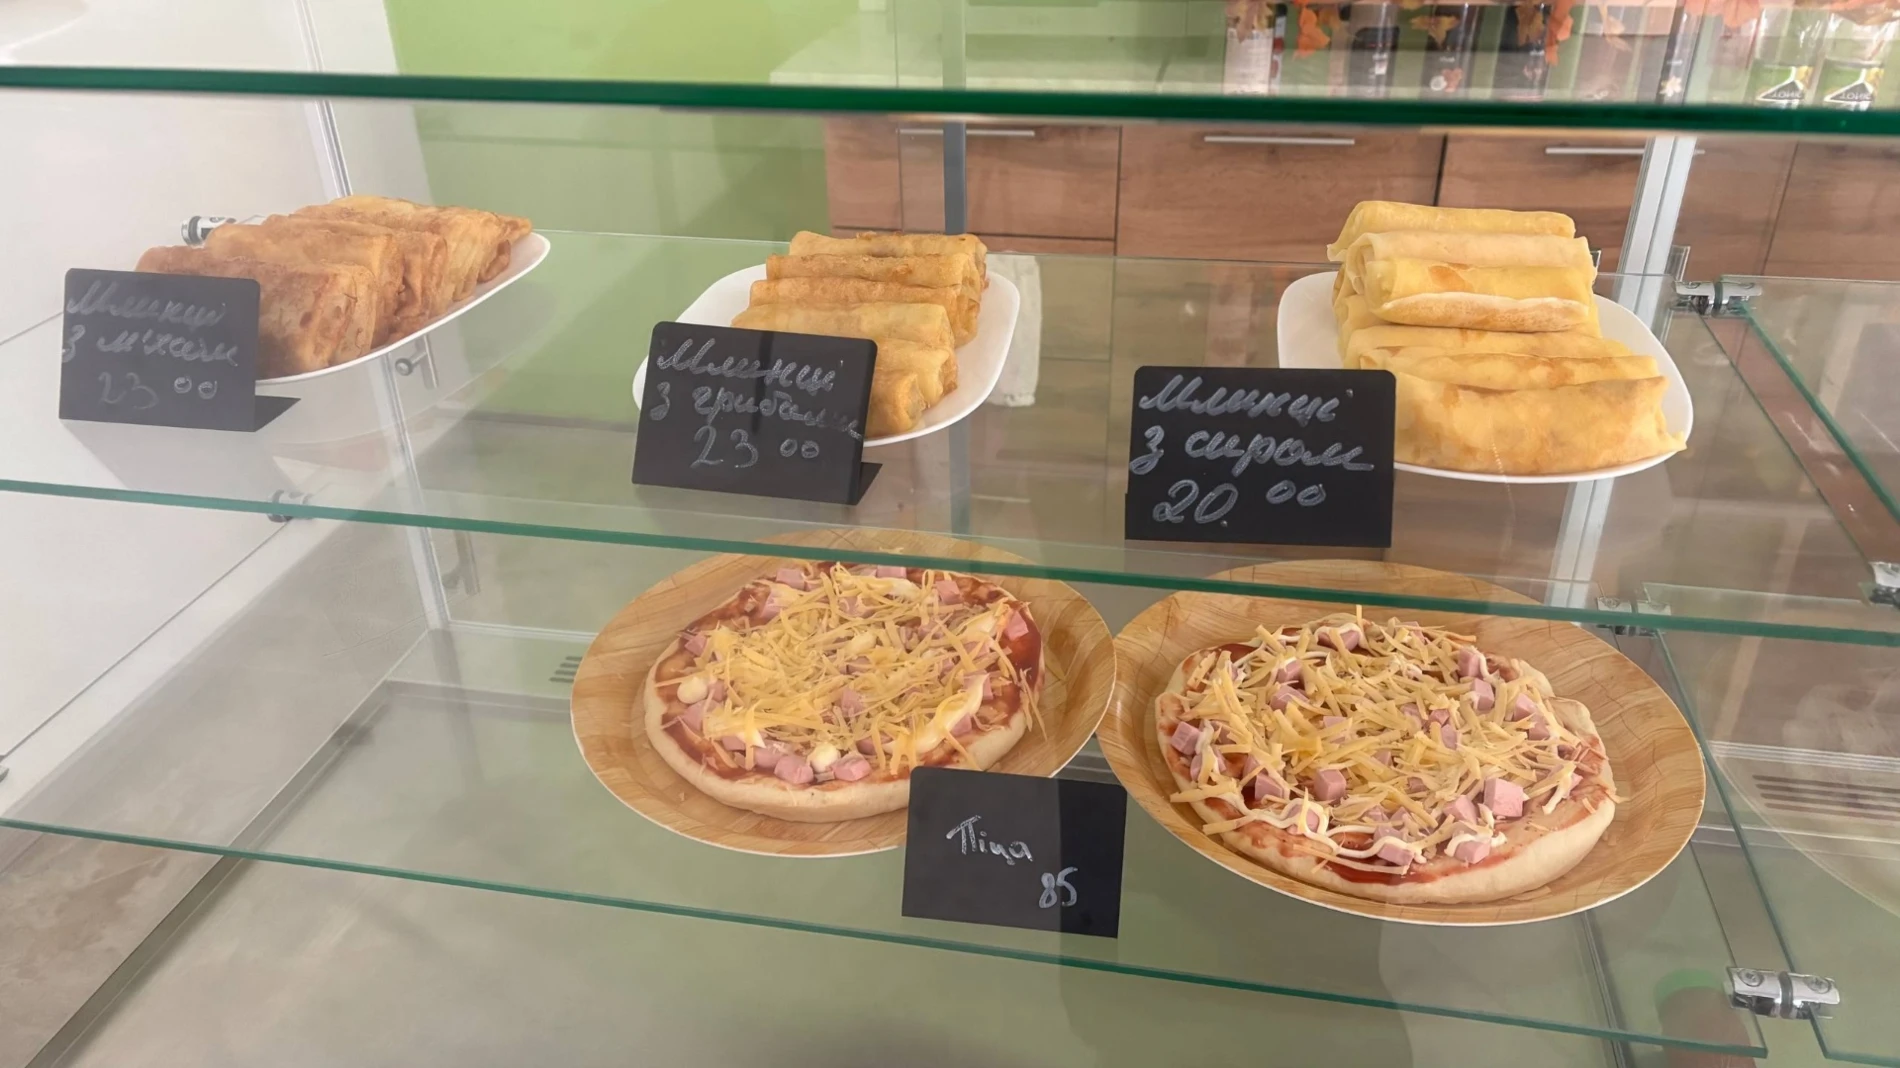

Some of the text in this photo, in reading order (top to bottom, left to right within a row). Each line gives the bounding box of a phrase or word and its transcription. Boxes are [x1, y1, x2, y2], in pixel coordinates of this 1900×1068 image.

[65, 279, 227, 332] Млинці
[98, 371, 160, 410] 23
[656, 337, 844, 396] Млинці
[1138, 373, 1354, 428] Млинці
[690, 424, 760, 468] 23
[1184, 430, 1375, 477] сиром
[945, 814, 1034, 866] Піца
[1038, 866, 1079, 909] 85
